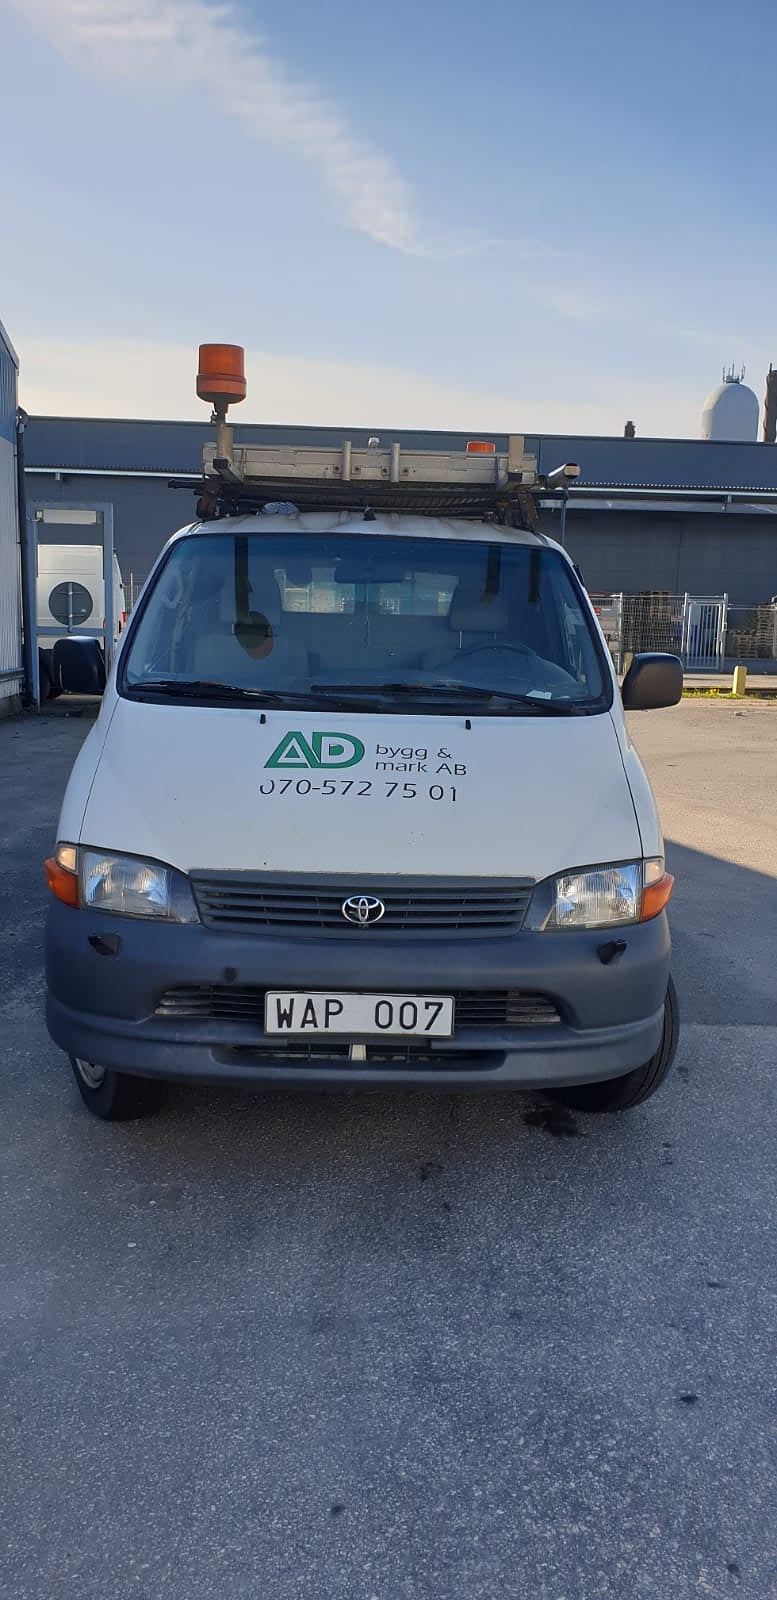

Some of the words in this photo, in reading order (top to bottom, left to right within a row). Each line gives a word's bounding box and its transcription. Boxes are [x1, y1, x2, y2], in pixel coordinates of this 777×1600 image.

[263, 731, 366, 769] AD
[375, 743, 428, 760] bygg
[436, 747, 453, 760] &
[375, 761, 428, 773] mark
[435, 763, 467, 776] AB
[259, 779, 373, 797] 070-572
[384, 782, 417, 799] 75
[428, 784, 458, 802] 01
[276, 997, 345, 1029] WAP
[374, 999, 444, 1031] 007
